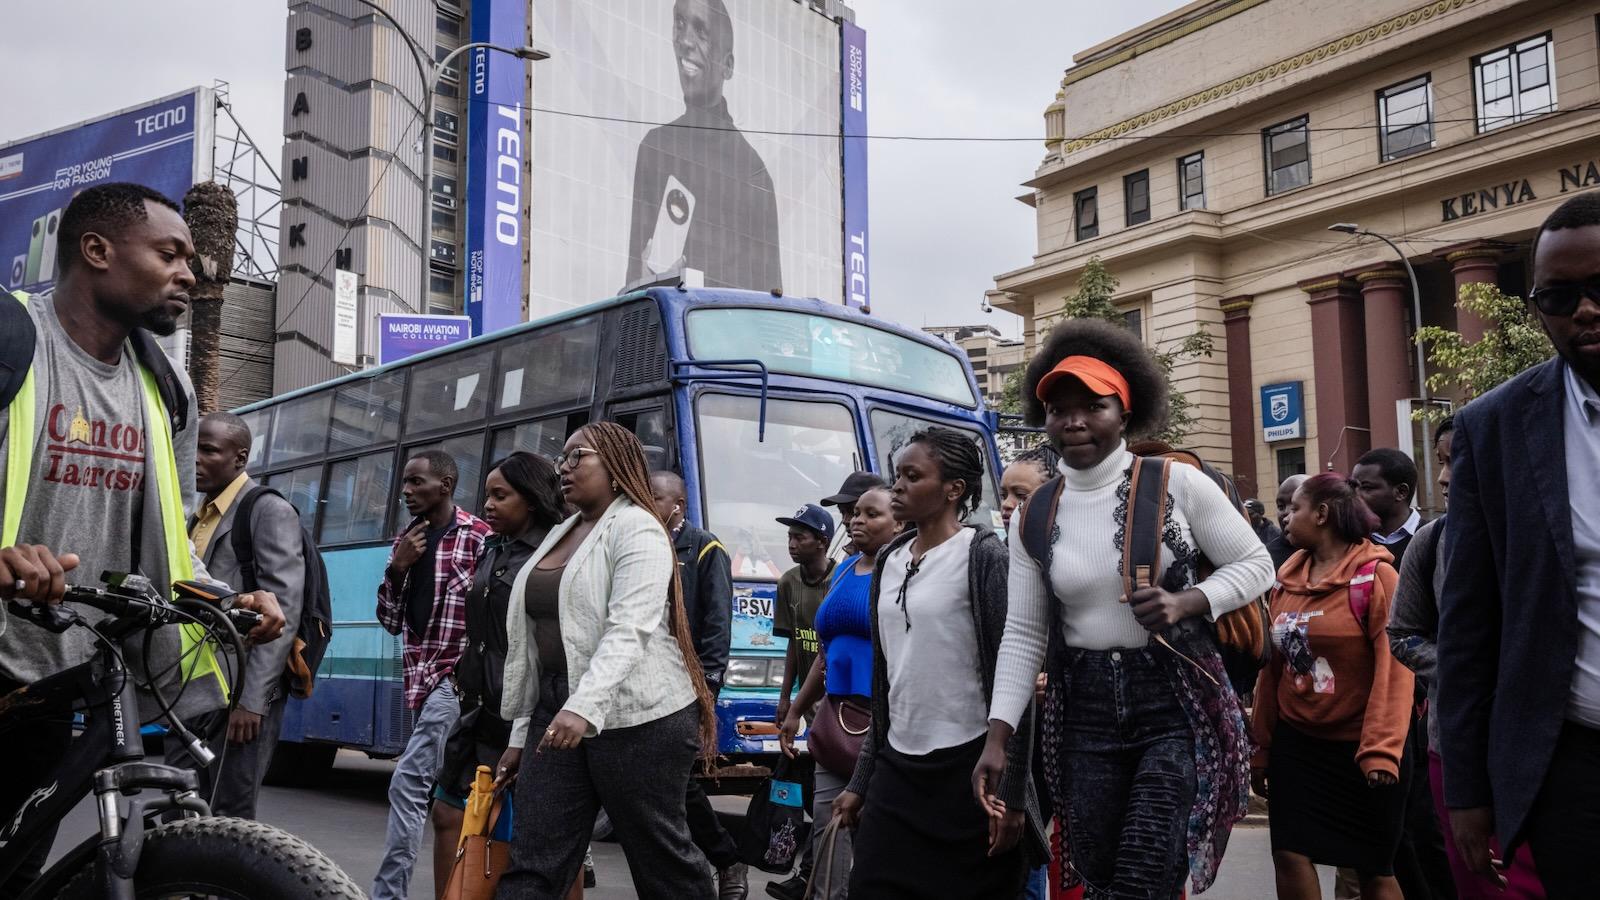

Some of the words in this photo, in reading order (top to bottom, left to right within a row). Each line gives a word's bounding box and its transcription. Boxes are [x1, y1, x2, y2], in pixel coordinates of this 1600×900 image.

[475, 47, 485, 95] TECNO
[135, 106, 186, 137] TECNO
[53, 177, 70, 191] FOR
[72, 167, 111, 186] PASSION
[55, 164, 81, 180] FOR
[82, 156, 112, 173] YOUNG
[496, 101, 520, 246] TECNO
[1440, 178, 1537, 222] KENYA
[389, 323, 422, 333] NAIROBI
[423, 324, 460, 335] AVIATION
[1268, 428, 1294, 437] PHILIPS
